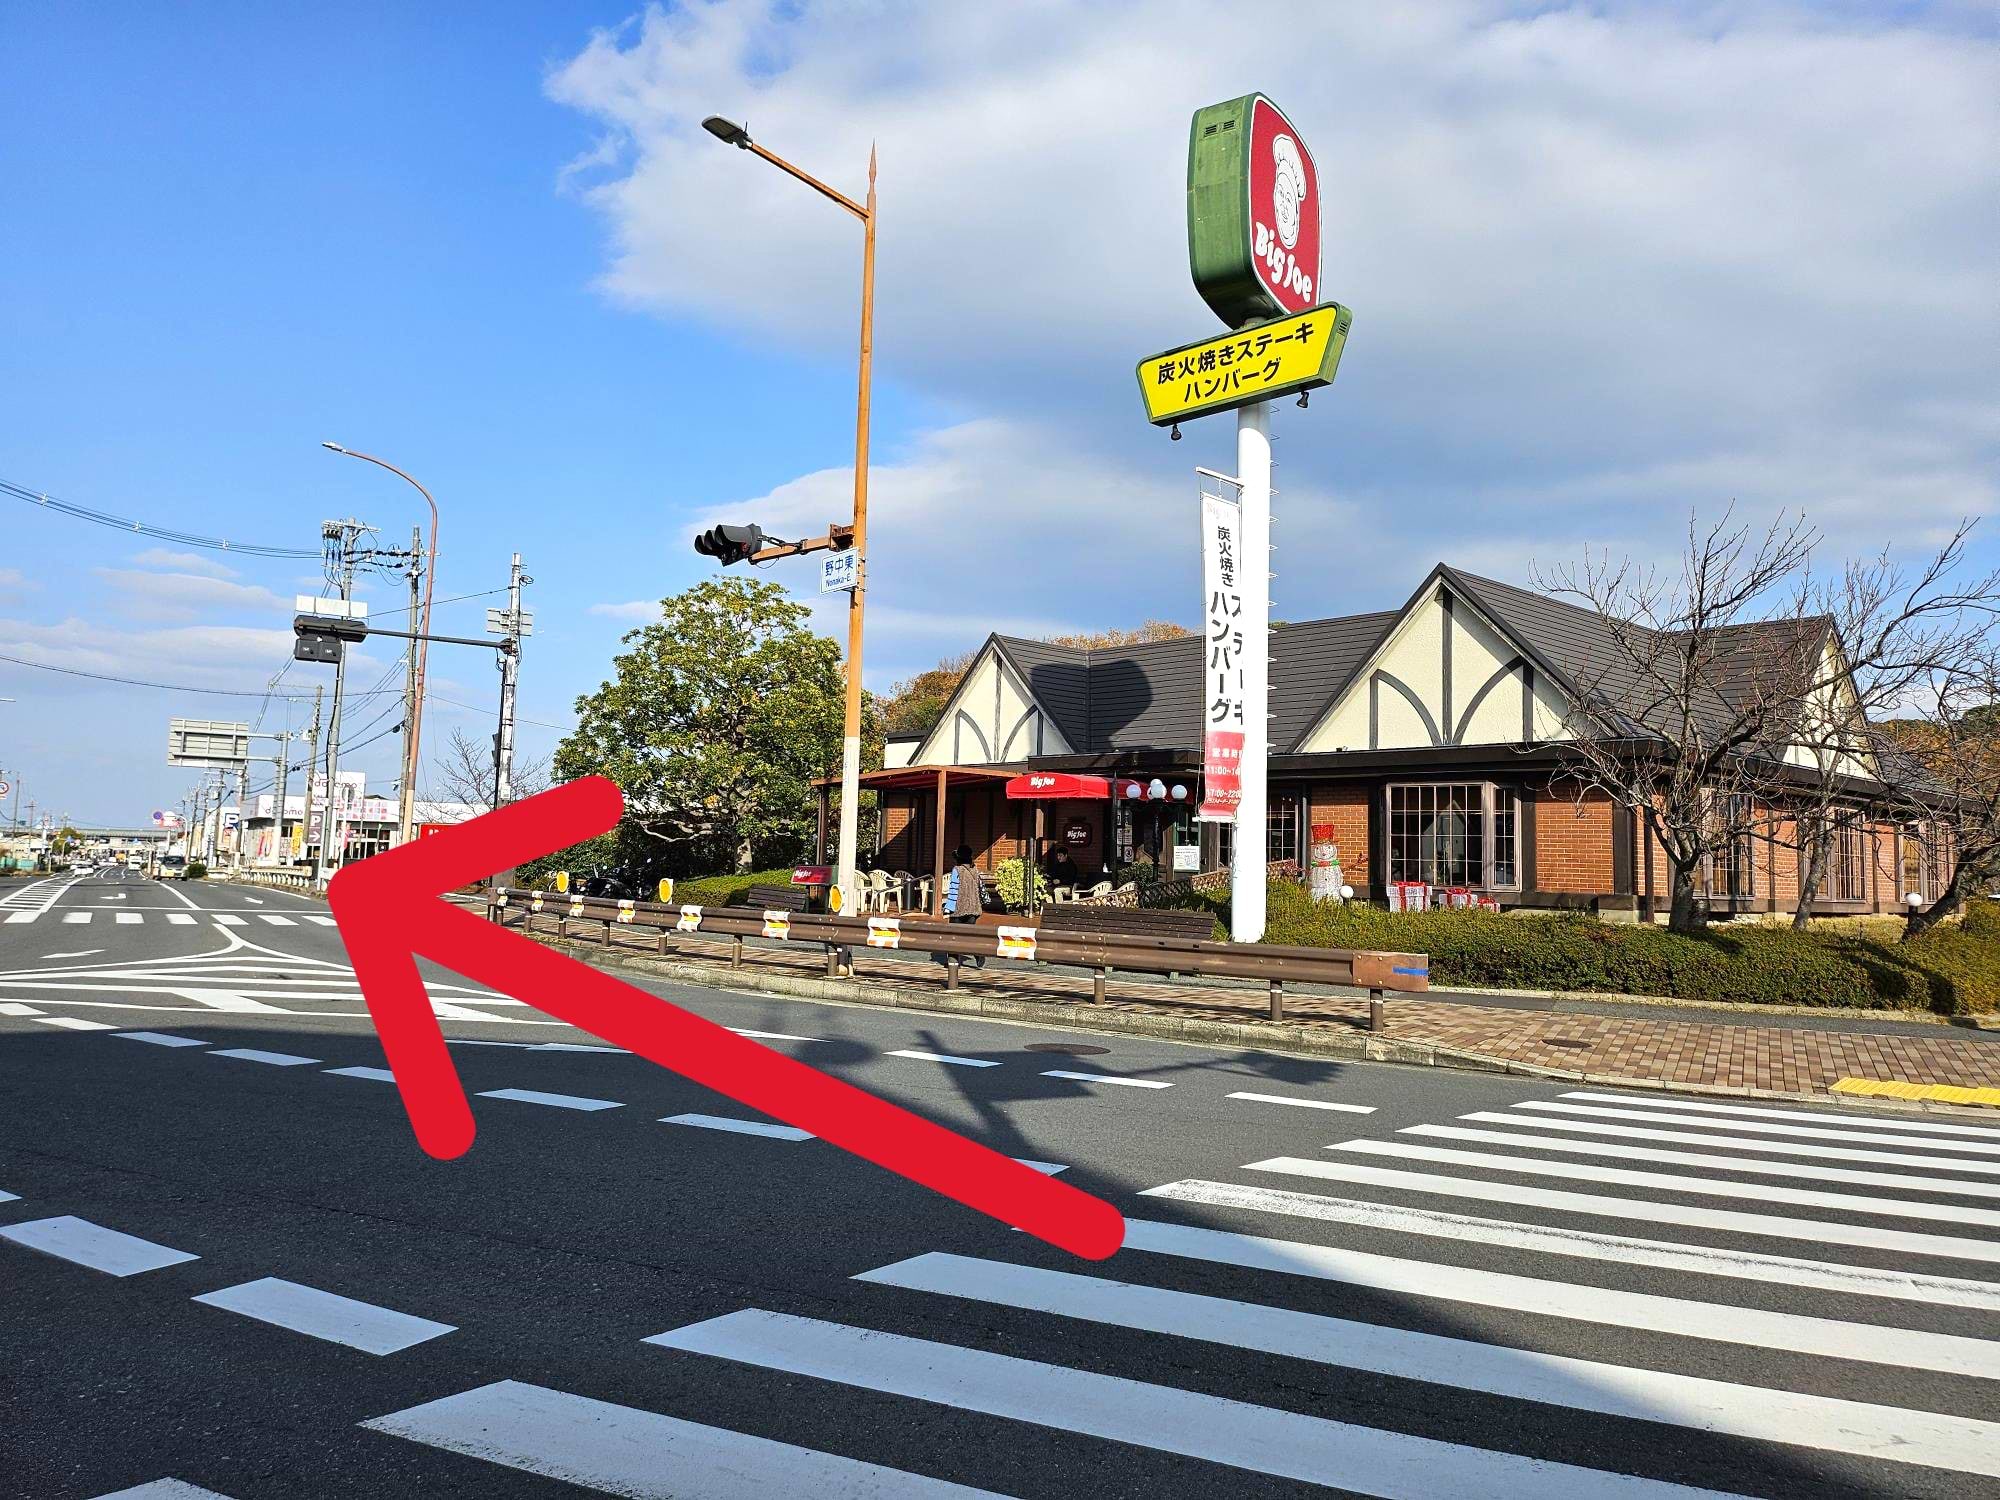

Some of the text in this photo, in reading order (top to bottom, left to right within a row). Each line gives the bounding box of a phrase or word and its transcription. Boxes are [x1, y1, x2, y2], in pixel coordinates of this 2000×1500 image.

[1254, 220, 1314, 303] Big Joe
[1157, 322, 1315, 385] 炭火焼きステーキ
[1183, 356, 1282, 403] ハンバーグ
[825, 554, 854, 577] 野中東
[1217, 525, 1234, 588] 炭火焼き
[1210, 590, 1232, 723] ハンバーグ
[1030, 776, 1056, 789] Big Joe
[310, 814, 321, 827] P
